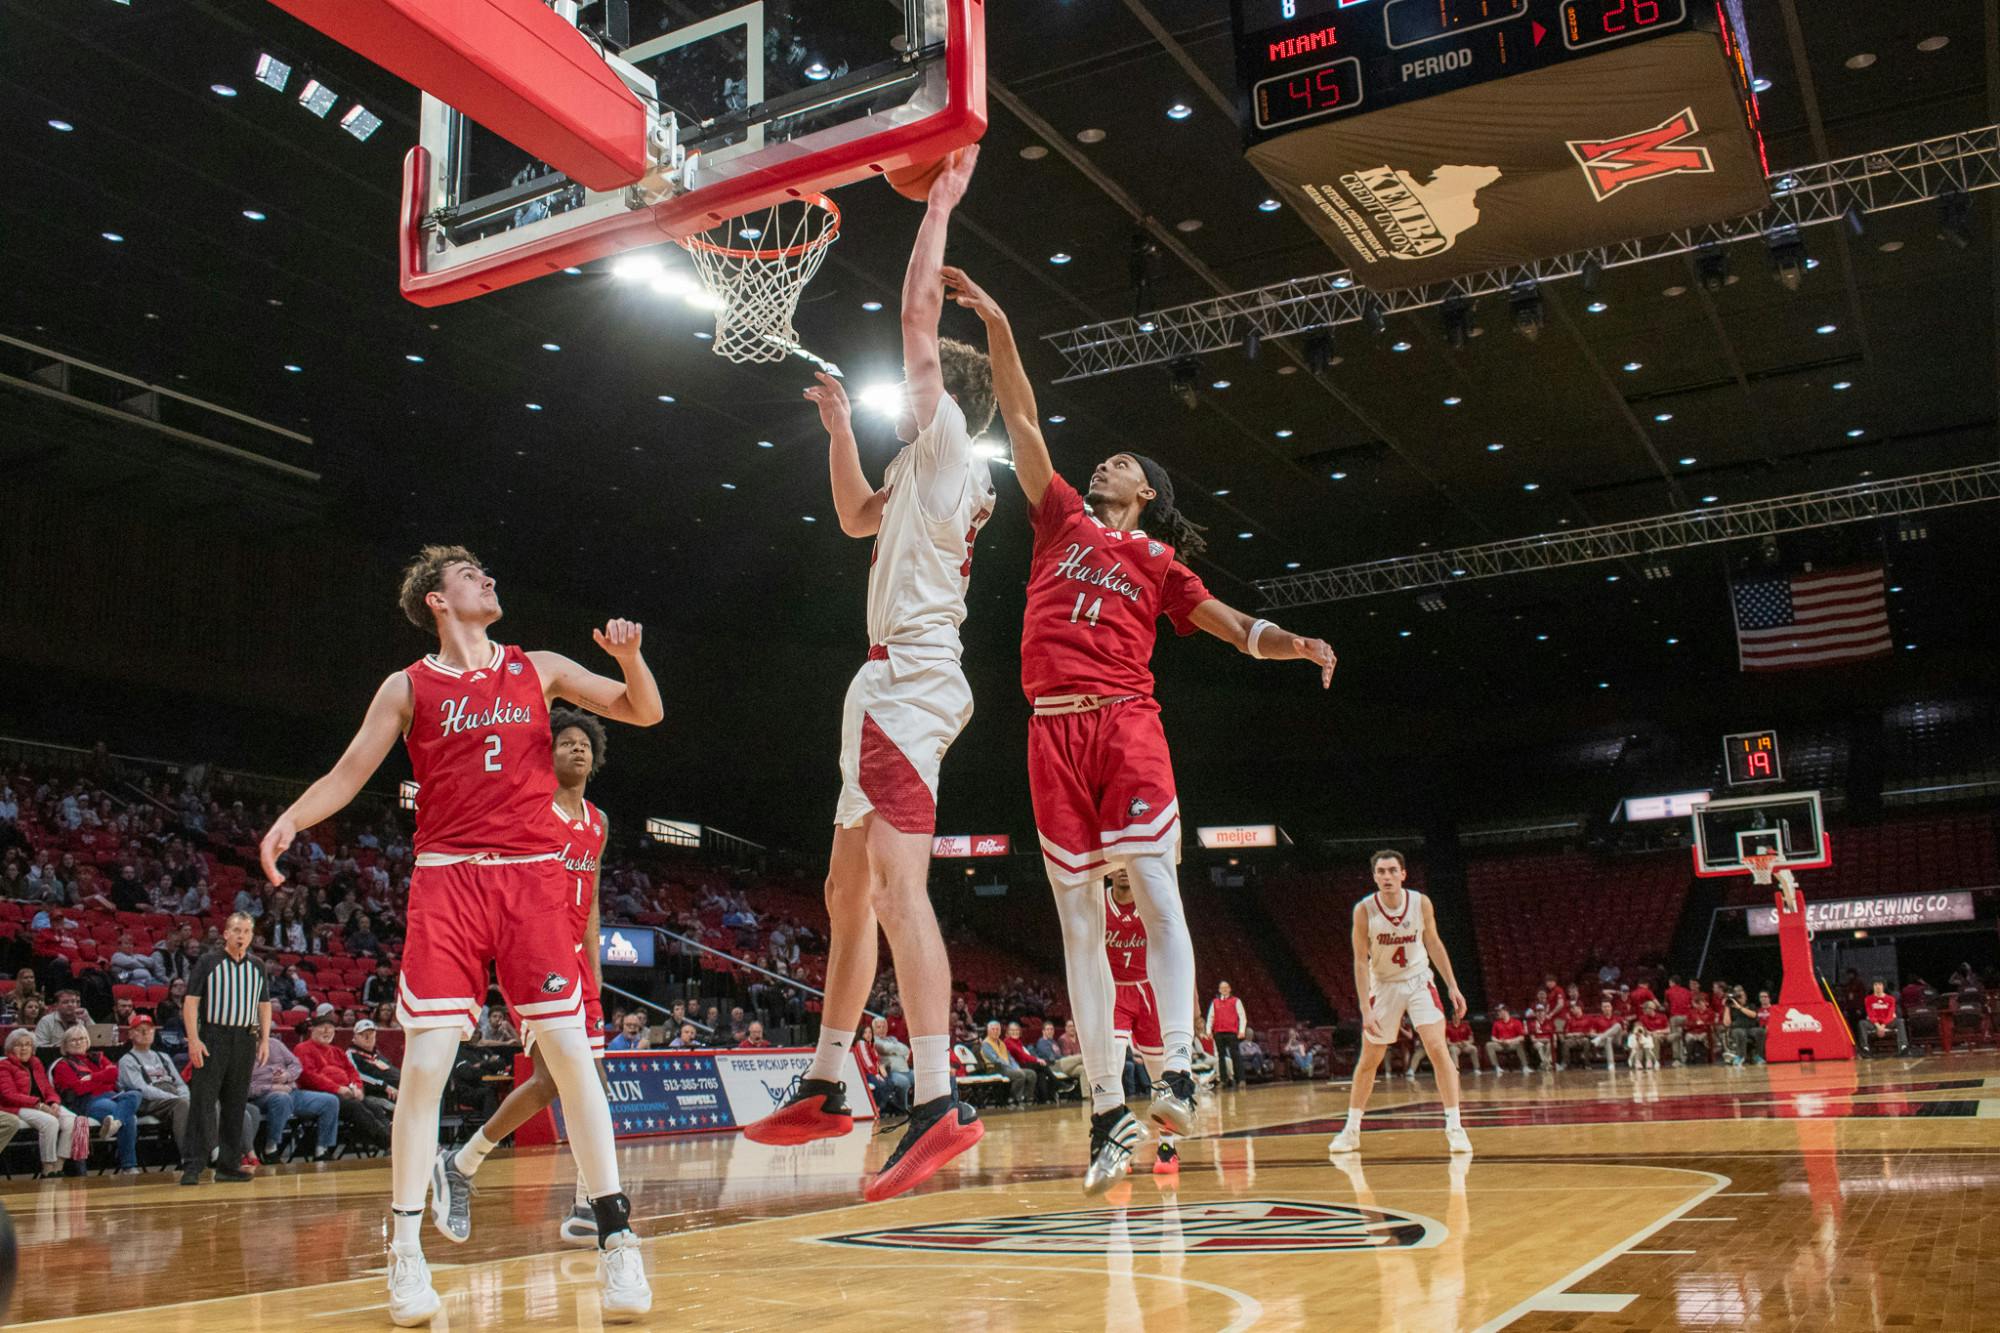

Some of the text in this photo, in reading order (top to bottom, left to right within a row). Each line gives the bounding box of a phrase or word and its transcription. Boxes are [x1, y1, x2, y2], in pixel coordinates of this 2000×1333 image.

[1269, 26, 1337, 62] MIAMI
[1401, 47, 1473, 82] PERIOD
[1288, 68, 1341, 111] 45
[1319, 201, 1354, 237] UNIVERSITY
[1339, 173, 1416, 255] CREDIT UNION
[1354, 164, 1447, 255] KEMBA
[1344, 208, 1369, 231] CREDIT
[1378, 244, 1390, 258] OF
[1053, 542, 1143, 602] Huskies
[1069, 591, 1103, 628] 14
[440, 695, 531, 738] Huskies
[484, 733, 502, 773] 2
[1747, 752, 1771, 777] 19
[1215, 827, 1258, 844] meijer
[575, 876, 584, 907] 1
[1819, 902, 1850, 922] CITY
[1853, 898, 1923, 917] BREWING
[1926, 895, 1952, 911] CO.
[1376, 929, 1418, 946] Miami
[1868, 915, 1895, 927] SINCE
[1122, 951, 1132, 969] 7
[1391, 945, 1408, 969] 4
[731, 1059, 757, 1071] FREE
[757, 1059, 789, 1071] PICKUP
[790, 1058, 808, 1069] FOR
[606, 1080, 643, 1102] AUN
